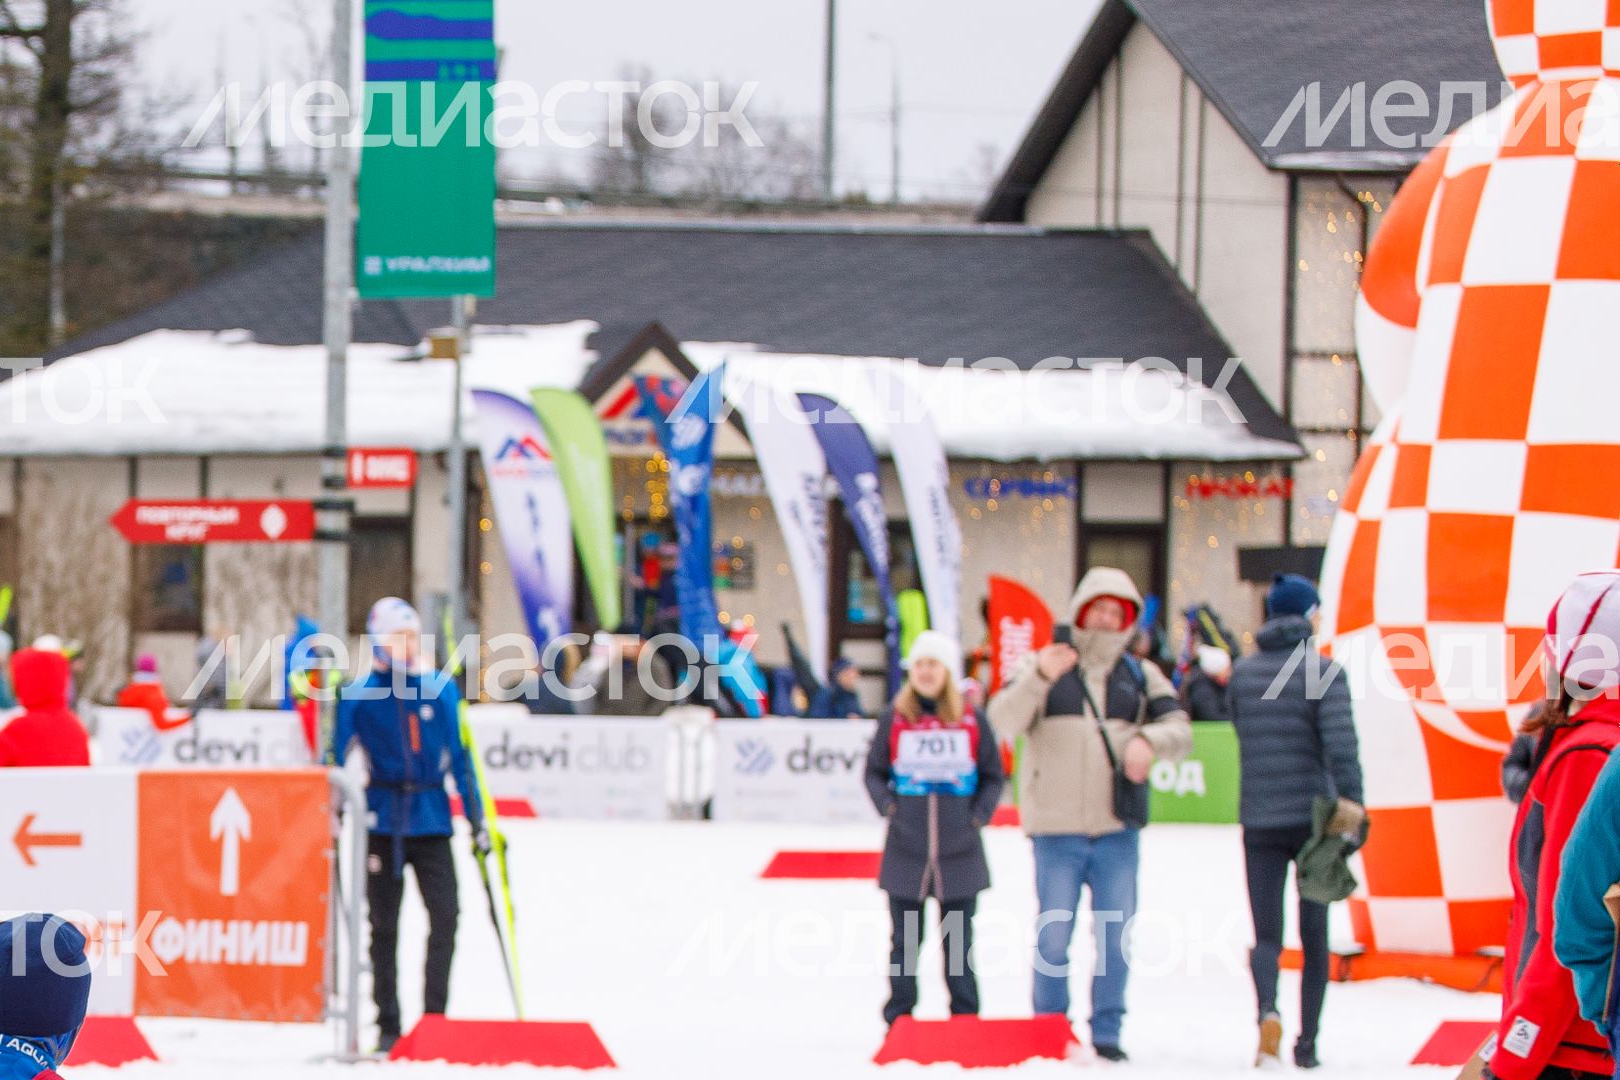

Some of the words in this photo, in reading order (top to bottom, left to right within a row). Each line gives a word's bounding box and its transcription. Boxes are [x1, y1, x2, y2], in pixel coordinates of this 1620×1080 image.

[174, 723, 262, 764] devi
[485, 727, 571, 771] devi
[916, 735, 958, 756] 701
[151, 917, 309, 967] ФИНИШ
